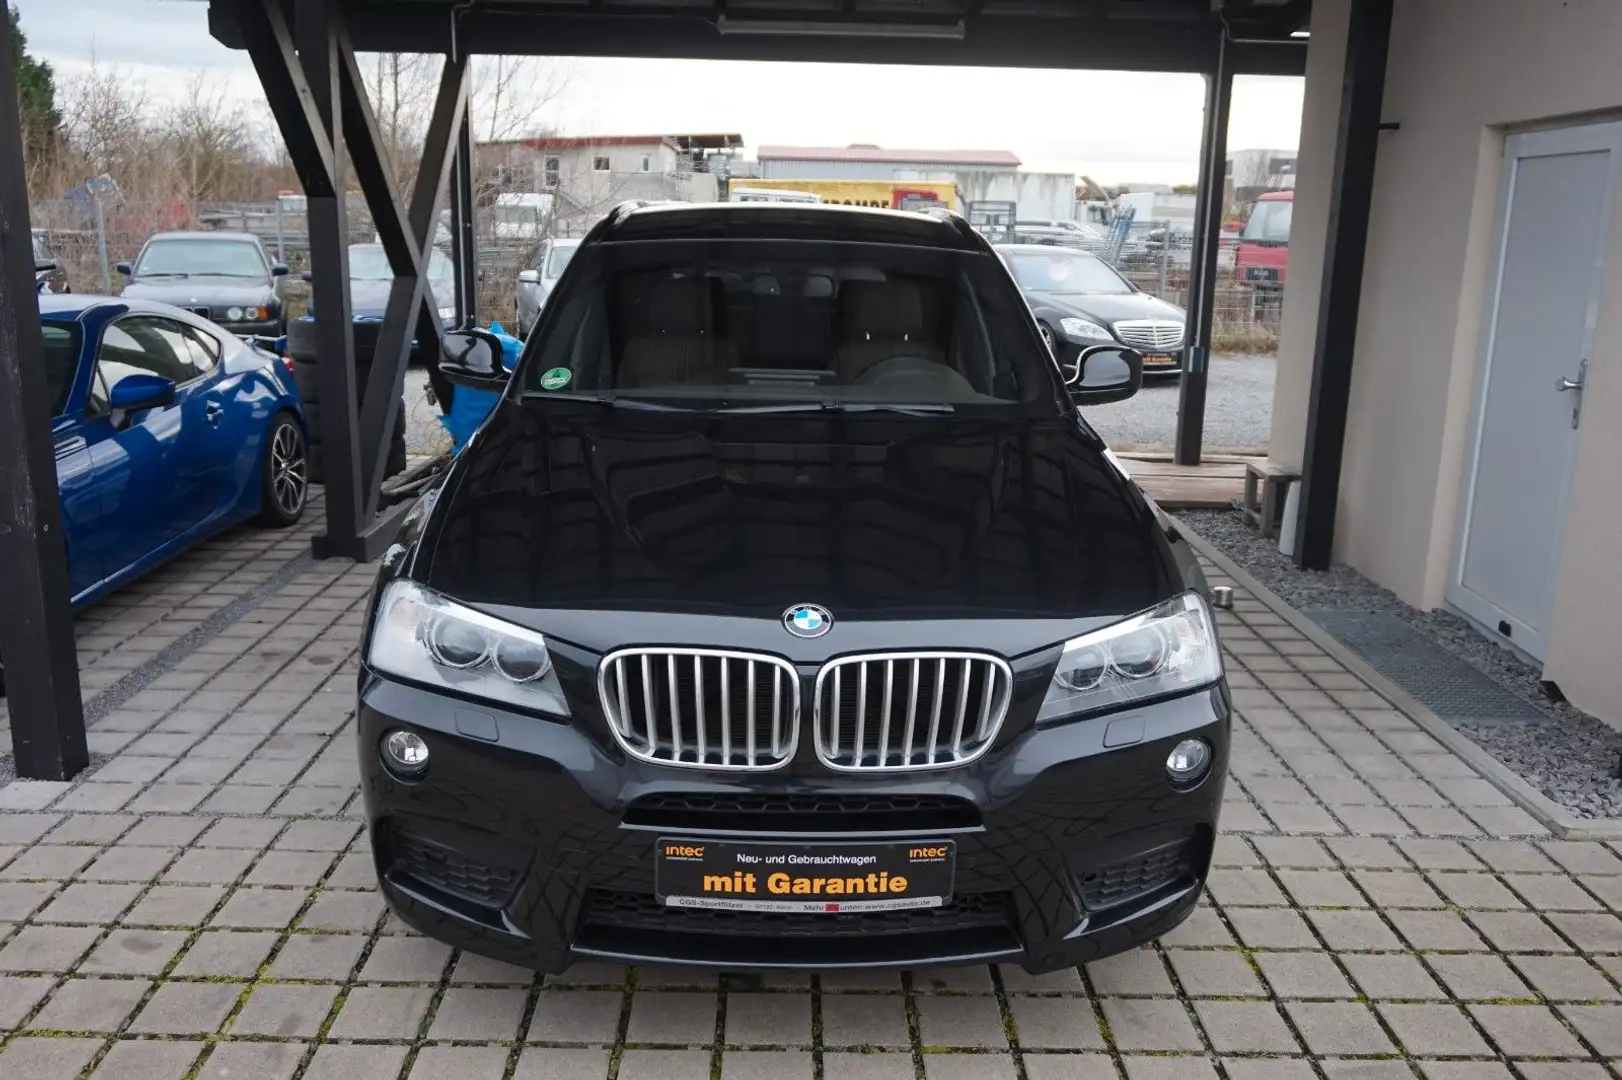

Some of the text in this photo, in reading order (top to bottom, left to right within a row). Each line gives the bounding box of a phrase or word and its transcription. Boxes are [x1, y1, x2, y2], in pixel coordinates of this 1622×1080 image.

[666, 846, 704, 857] intec
[909, 847, 946, 858] intec
[737, 853, 877, 866] Neu- und Gebrauchtwagen
[703, 871, 908, 894] mit Garantie
